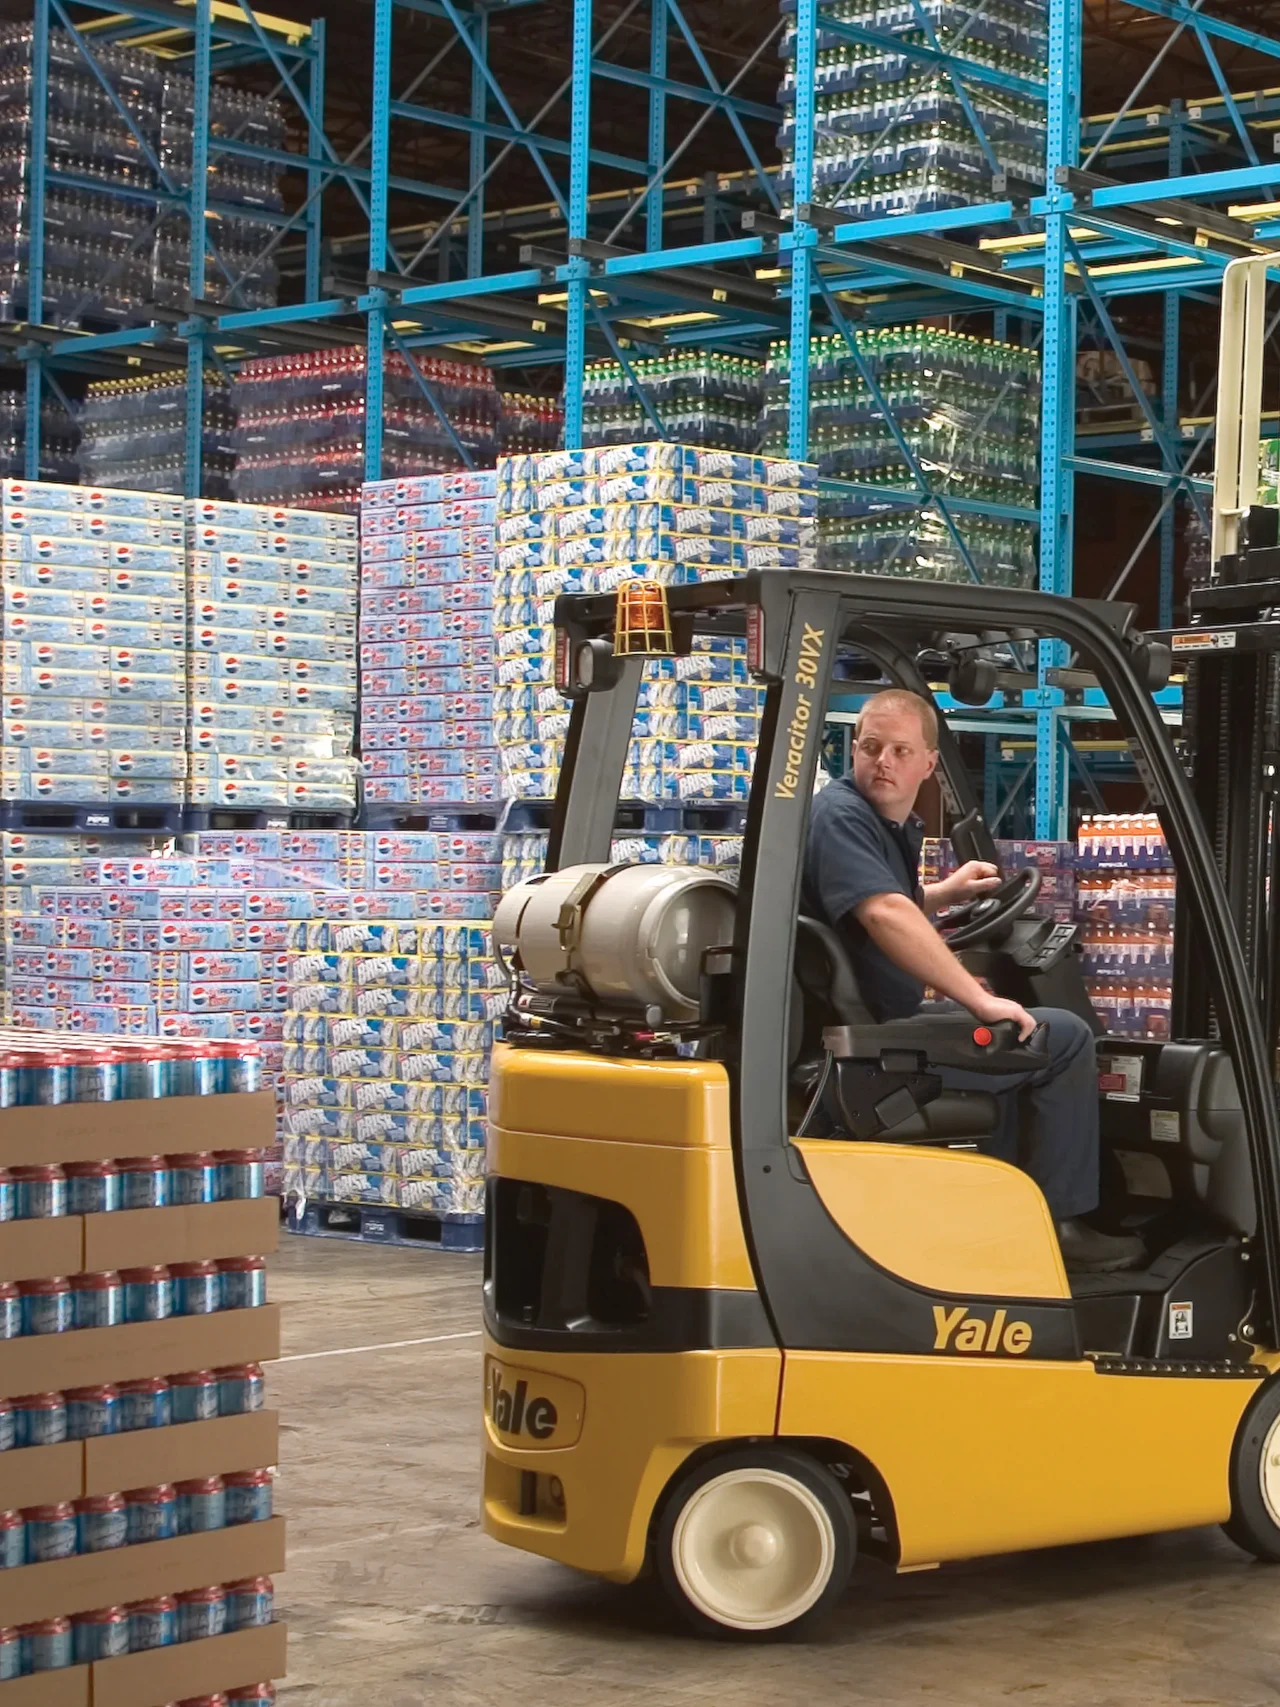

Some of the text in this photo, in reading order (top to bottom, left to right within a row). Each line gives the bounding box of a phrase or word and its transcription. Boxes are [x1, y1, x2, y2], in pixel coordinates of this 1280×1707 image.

[700, 453, 738, 477] BRISK
[767, 463, 805, 486] BRISK
[700, 483, 738, 506] BRISK
[767, 492, 805, 514] BRISK
[676, 509, 716, 533] BRISK
[747, 518, 785, 542] BRISK
[676, 538, 717, 563] BRISK
[676, 655, 717, 681] BRISK
[703, 686, 742, 711] BRISK
[775, 622, 825, 799] Veracitor 30VX
[703, 715, 742, 741] BRISK
[679, 743, 720, 770] BRISK
[679, 772, 719, 800] BRISK
[335, 925, 375, 953] BRISK
[357, 957, 400, 986] BRISK
[357, 988, 400, 1017] BRISK
[332, 1019, 376, 1047] BRISK
[402, 1022, 443, 1050] BRISK
[402, 1053, 443, 1082] BRISK
[355, 1082, 397, 1111] BRISK
[333, 1142, 374, 1171] BRISK
[401, 1148, 442, 1178] BRISK
[333, 1173, 374, 1201] BRISK
[401, 1179, 442, 1208] BRISK
[932, 1306, 1033, 1354] Yale
[492, 1368, 558, 1440] Yale
